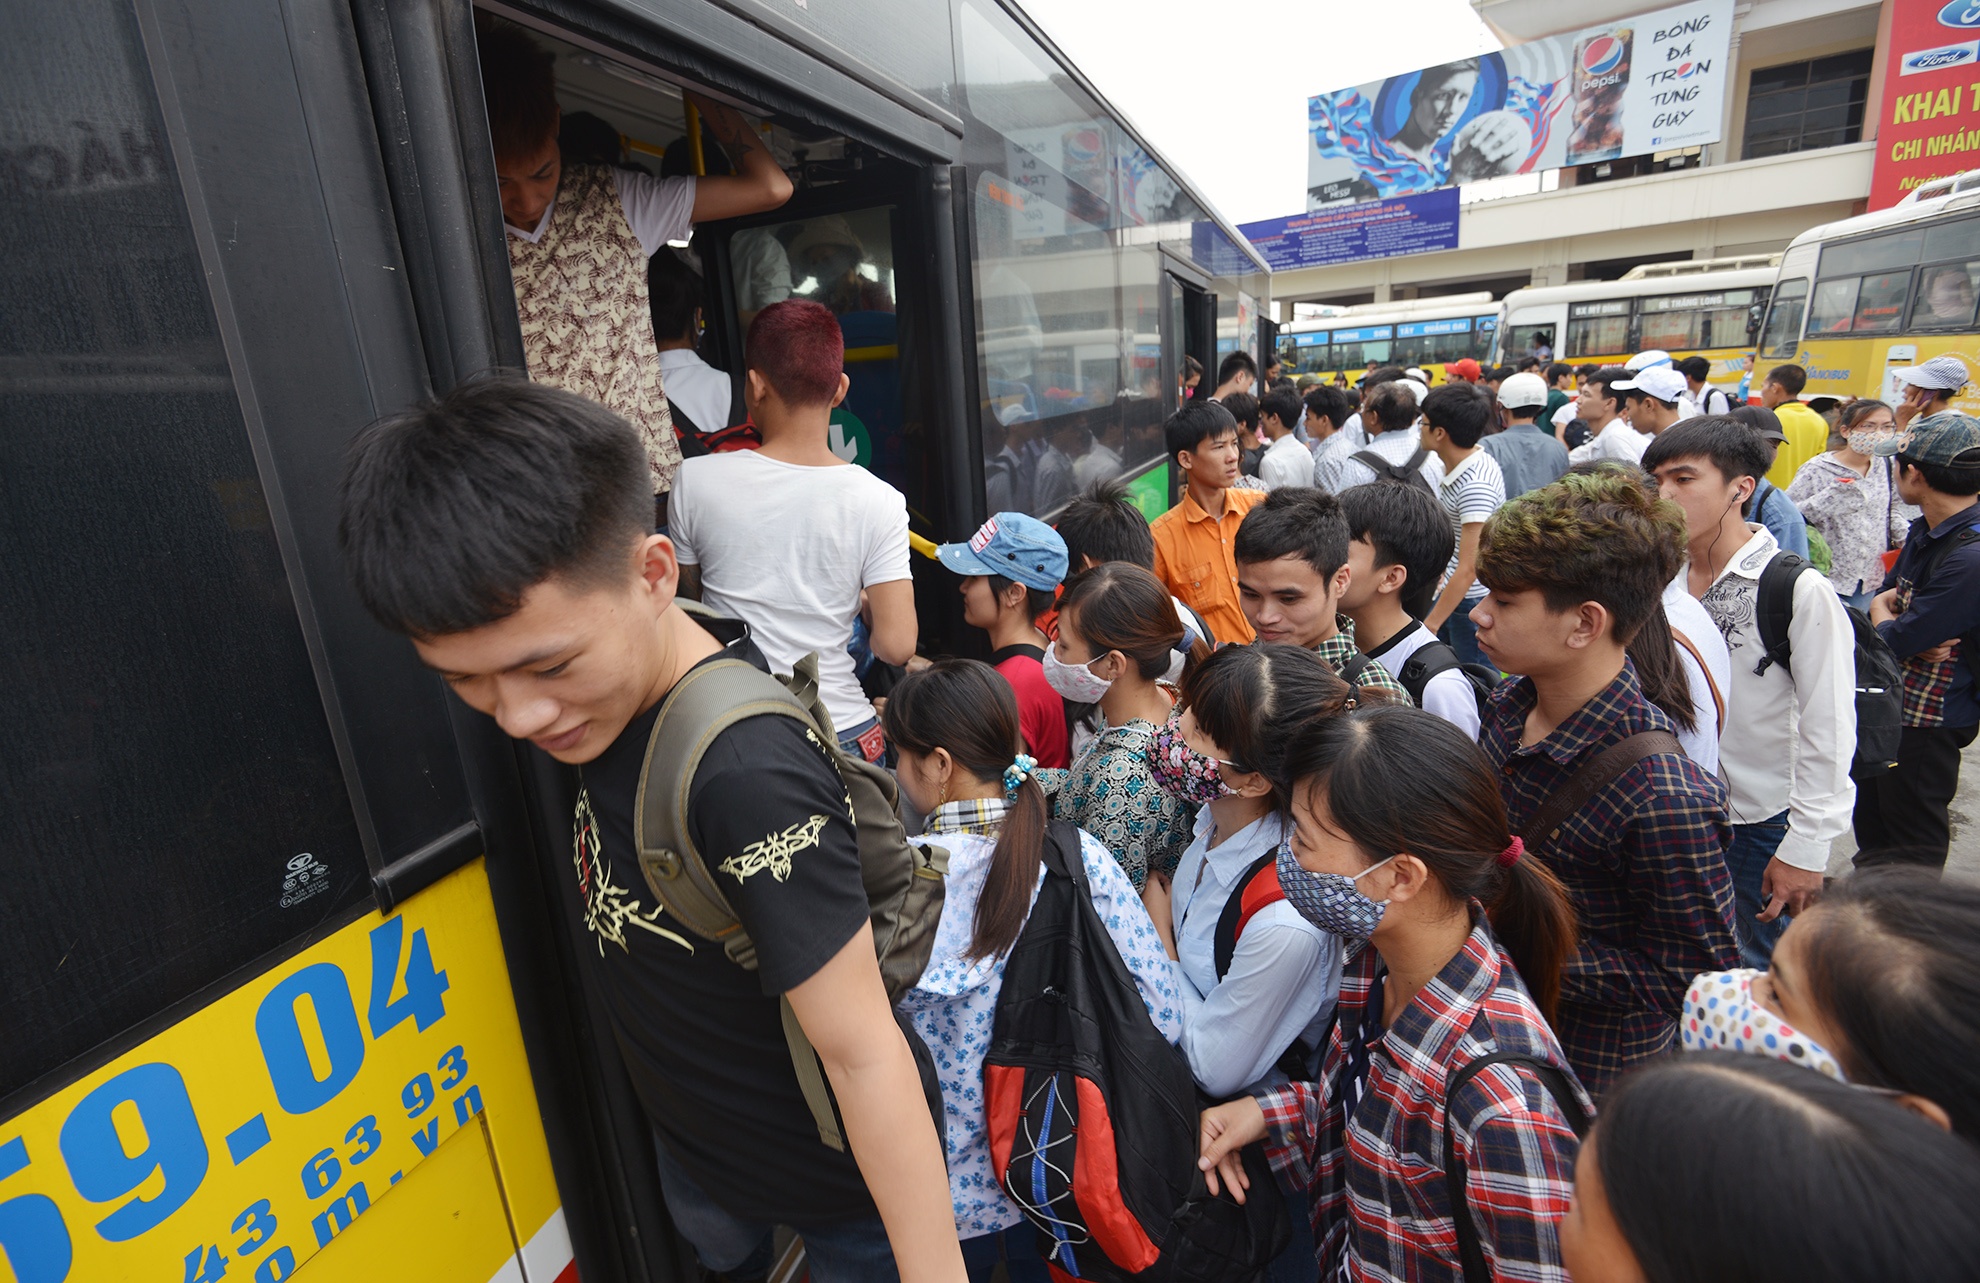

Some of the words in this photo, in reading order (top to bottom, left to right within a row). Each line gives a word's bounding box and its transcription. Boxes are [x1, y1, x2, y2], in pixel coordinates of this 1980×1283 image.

[1652, 14, 1711, 44] BÓNG
[1666, 39, 1695, 62] ĐÁ
[1917, 51, 1961, 68] Ford
[1581, 71, 1621, 92] pepsi
[1893, 86, 1963, 125] KHAI
[1891, 138, 1923, 162] CHI
[1700, 295, 1723, 306] LONG
[301, 1114, 382, 1200] 63
[401, 1045, 469, 1119] 93
